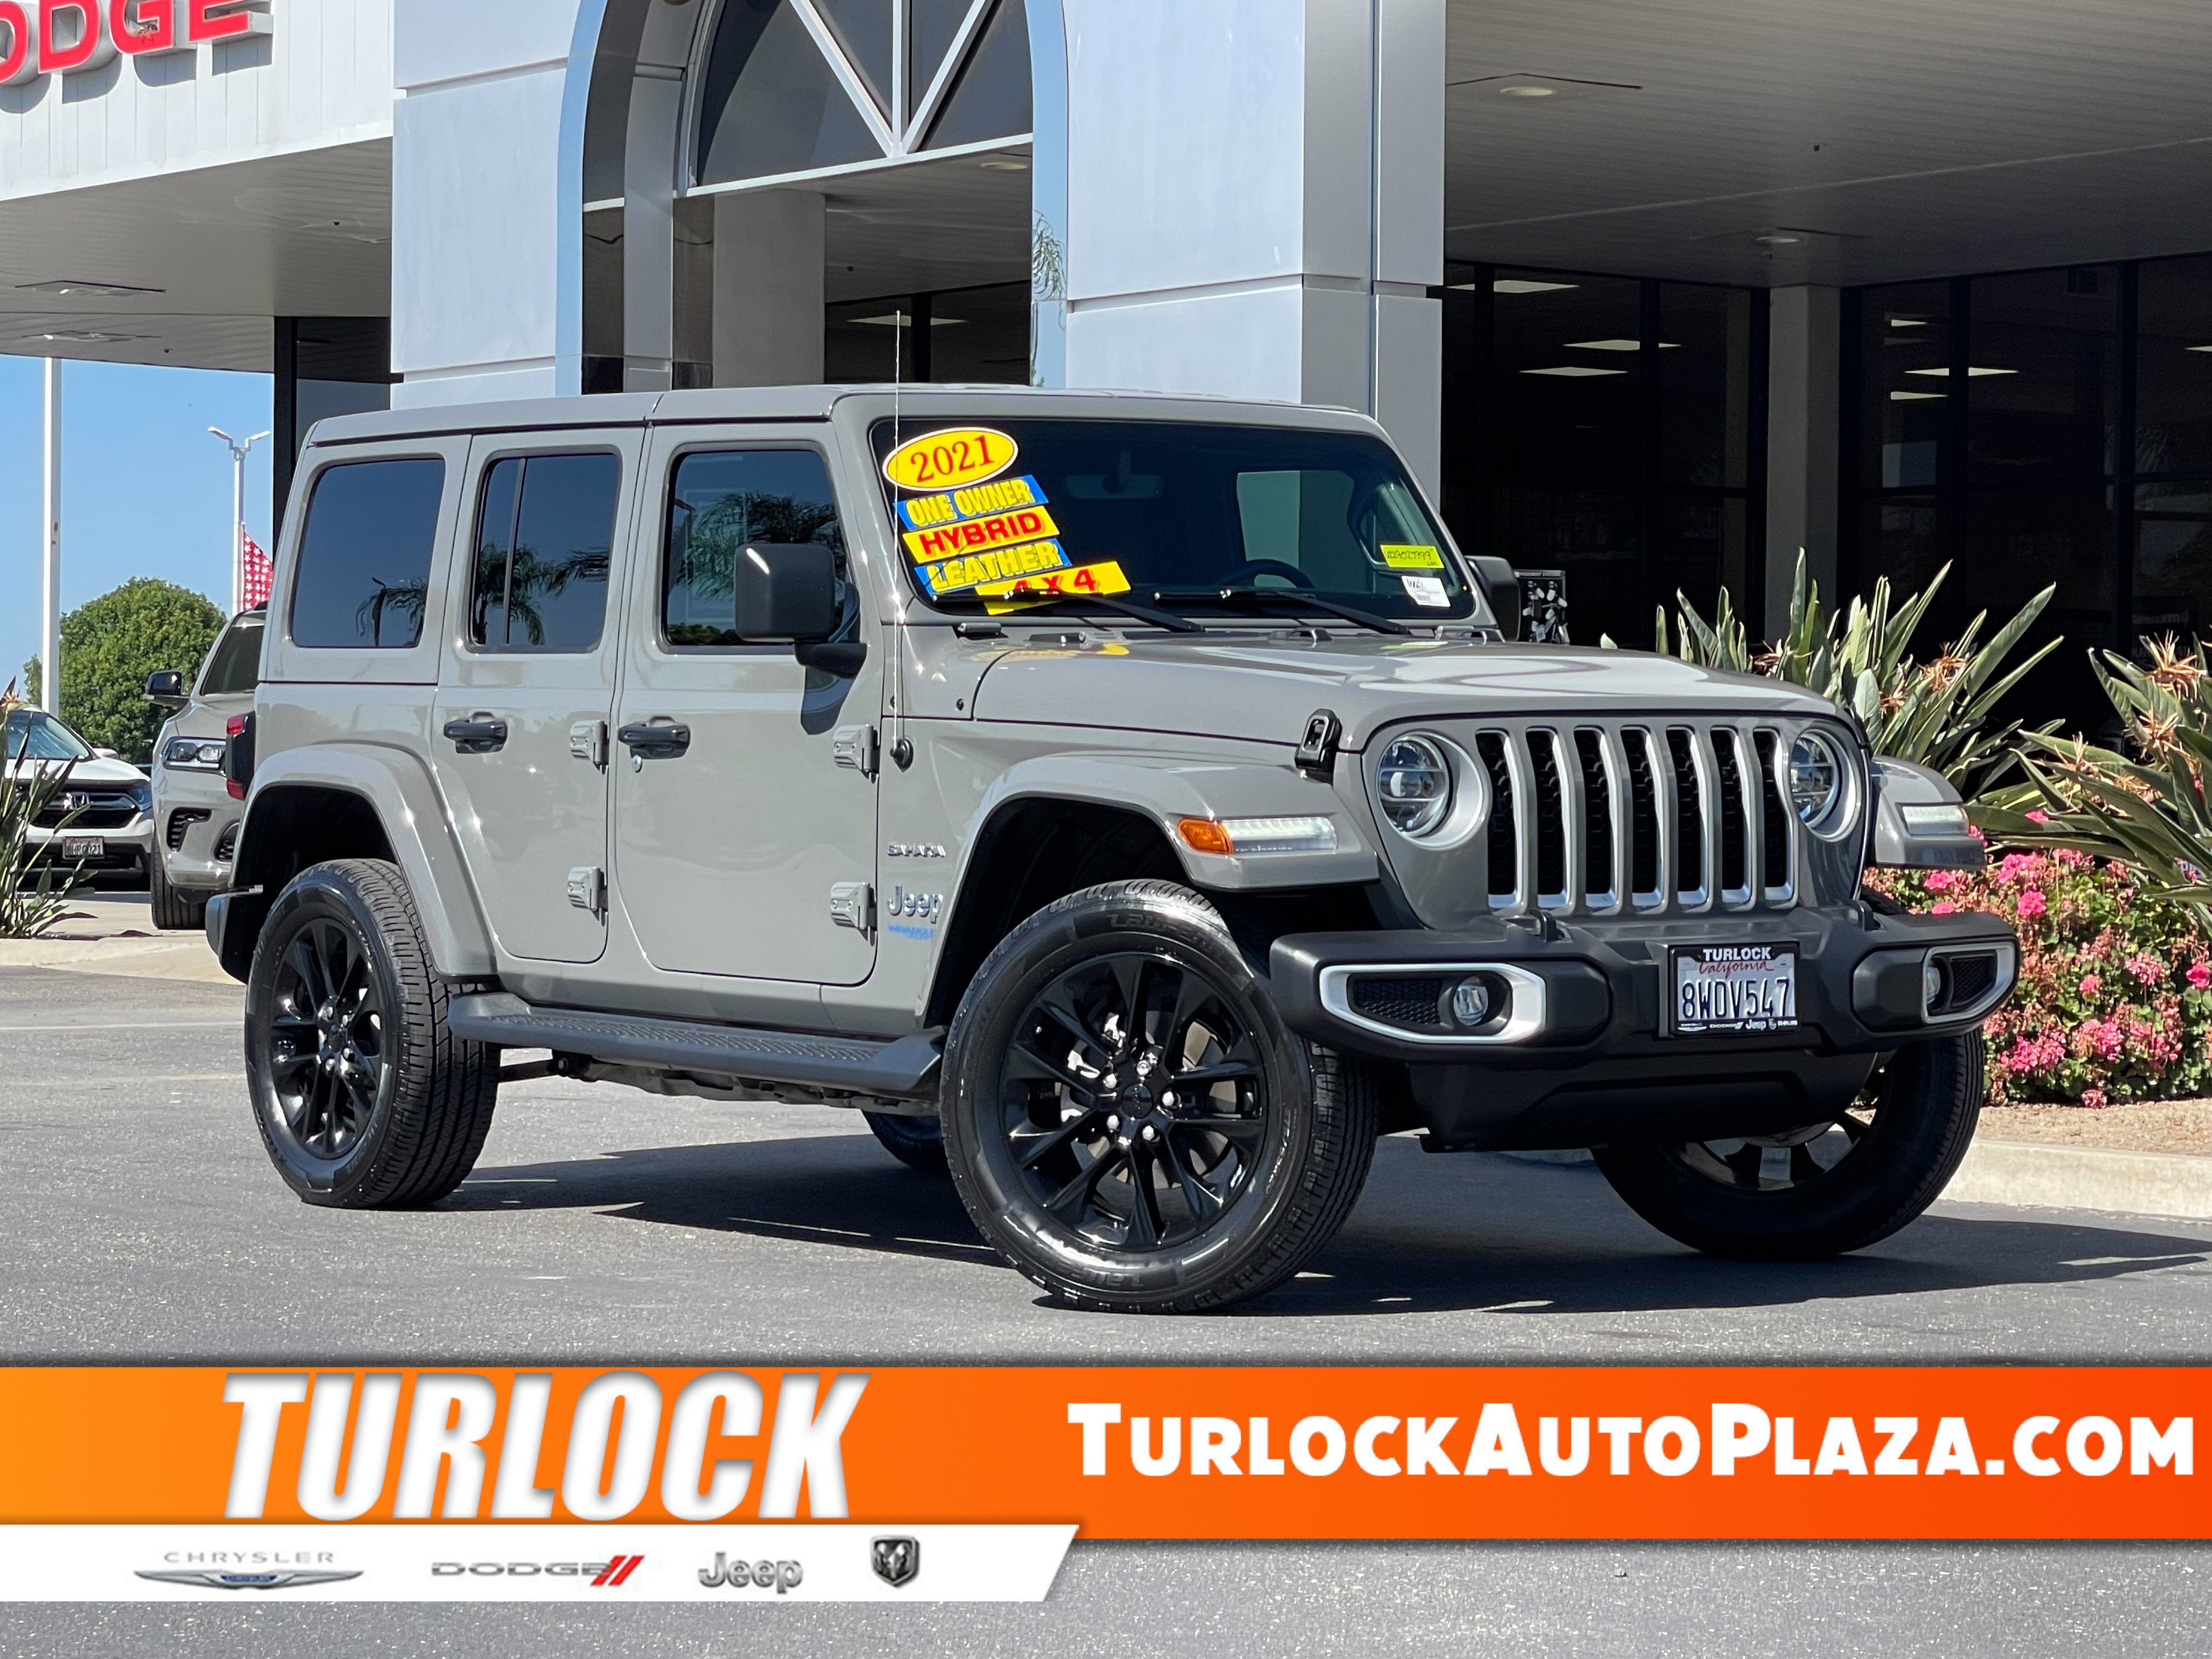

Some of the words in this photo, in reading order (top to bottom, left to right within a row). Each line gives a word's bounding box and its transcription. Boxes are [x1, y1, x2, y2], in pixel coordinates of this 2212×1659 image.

[911, 435, 995, 483] 2021
[906, 495, 955, 526] ONE
[955, 479, 1035, 516] OWNER
[919, 512, 1042, 555] HYBRID
[927, 541, 1063, 592] LEATHER
[887, 843, 946, 857] SAHARA
[887, 884, 943, 924] Jeep
[1699, 961, 1775, 978] California
[1703, 947, 1771, 961] TURLOCK
